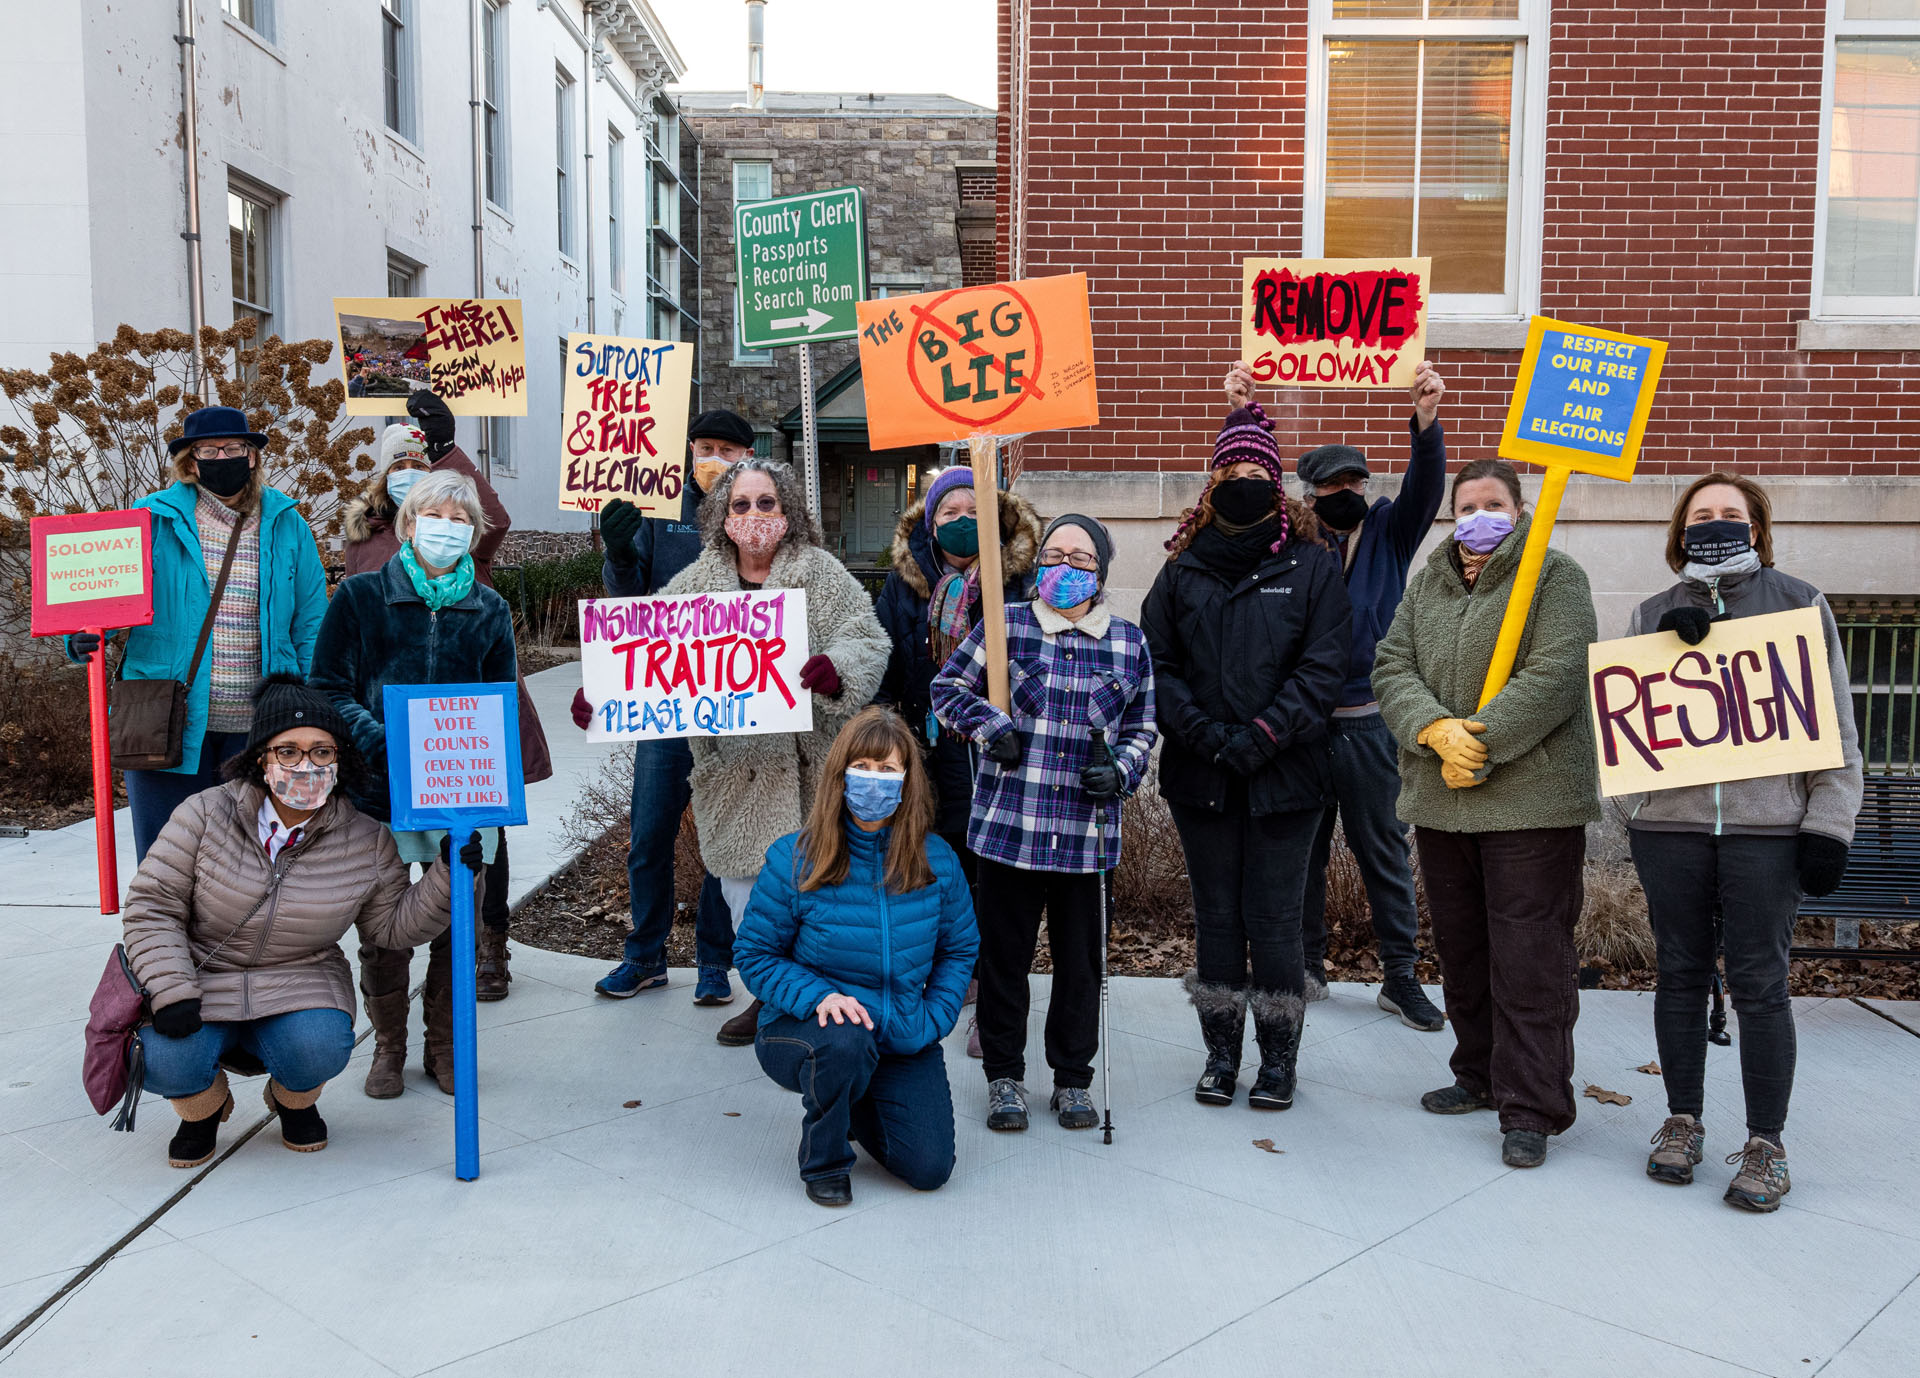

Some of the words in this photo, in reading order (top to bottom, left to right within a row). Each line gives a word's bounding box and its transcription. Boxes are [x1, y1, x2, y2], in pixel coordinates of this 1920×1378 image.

[742, 206, 801, 238] County
[810, 197, 855, 228] Clerk
[752, 235, 828, 264] Passports
[753, 260, 827, 287] Recording
[754, 287, 804, 311] Search
[812, 284, 853, 304] Room
[1255, 276, 1408, 340] REMOVE
[416, 305, 442, 337] I
[440, 300, 483, 326] WAS
[427, 305, 519, 352] HERE!
[863, 309, 904, 346] THE
[917, 301, 1023, 363] BIG
[575, 341, 675, 386] SUPPORT
[1562, 335, 1636, 360] RESPECT
[431, 349, 481, 384] SUSAN
[432, 359, 496, 399] SOLOWAY
[496, 364, 525, 398] 1/6/21
[940, 349, 1026, 403] LIE
[1251, 351, 1398, 385] SOLOWAY
[1551, 354, 1592, 373] OUR
[1597, 361, 1638, 380] FREE
[587, 376, 650, 414] FREE
[1567, 378, 1610, 396] AND
[1562, 402, 1603, 422] FAIR
[567, 411, 595, 456] &
[598, 411, 658, 457] FAIR
[1530, 418, 1625, 446] ELECTIONS
[566, 456, 682, 499] ELECTIONS
[49, 537, 139, 557] SOLOWAY:
[50, 567, 94, 580] WHICH
[98, 564, 138, 576] VOTES
[69, 579, 119, 592] COUNT?
[583, 592, 785, 643] INSURRECTIONIST
[612, 634, 797, 710] TRAITOR
[428, 697, 480, 712] EVERY
[598, 698, 688, 734] PLEASE
[694, 692, 757, 734] QUIT.
[1594, 635, 1820, 772] RESIGN
[433, 716, 478, 731] VOTE
[423, 735, 490, 751] COUNTS
[424, 759, 465, 774] (EVEN
[469, 758, 496, 770] THE
[426, 775, 463, 788] ONES
[467, 774, 495, 787] YOU
[420, 792, 462, 805] DON'T
[466, 791, 503, 804] LIKE)
